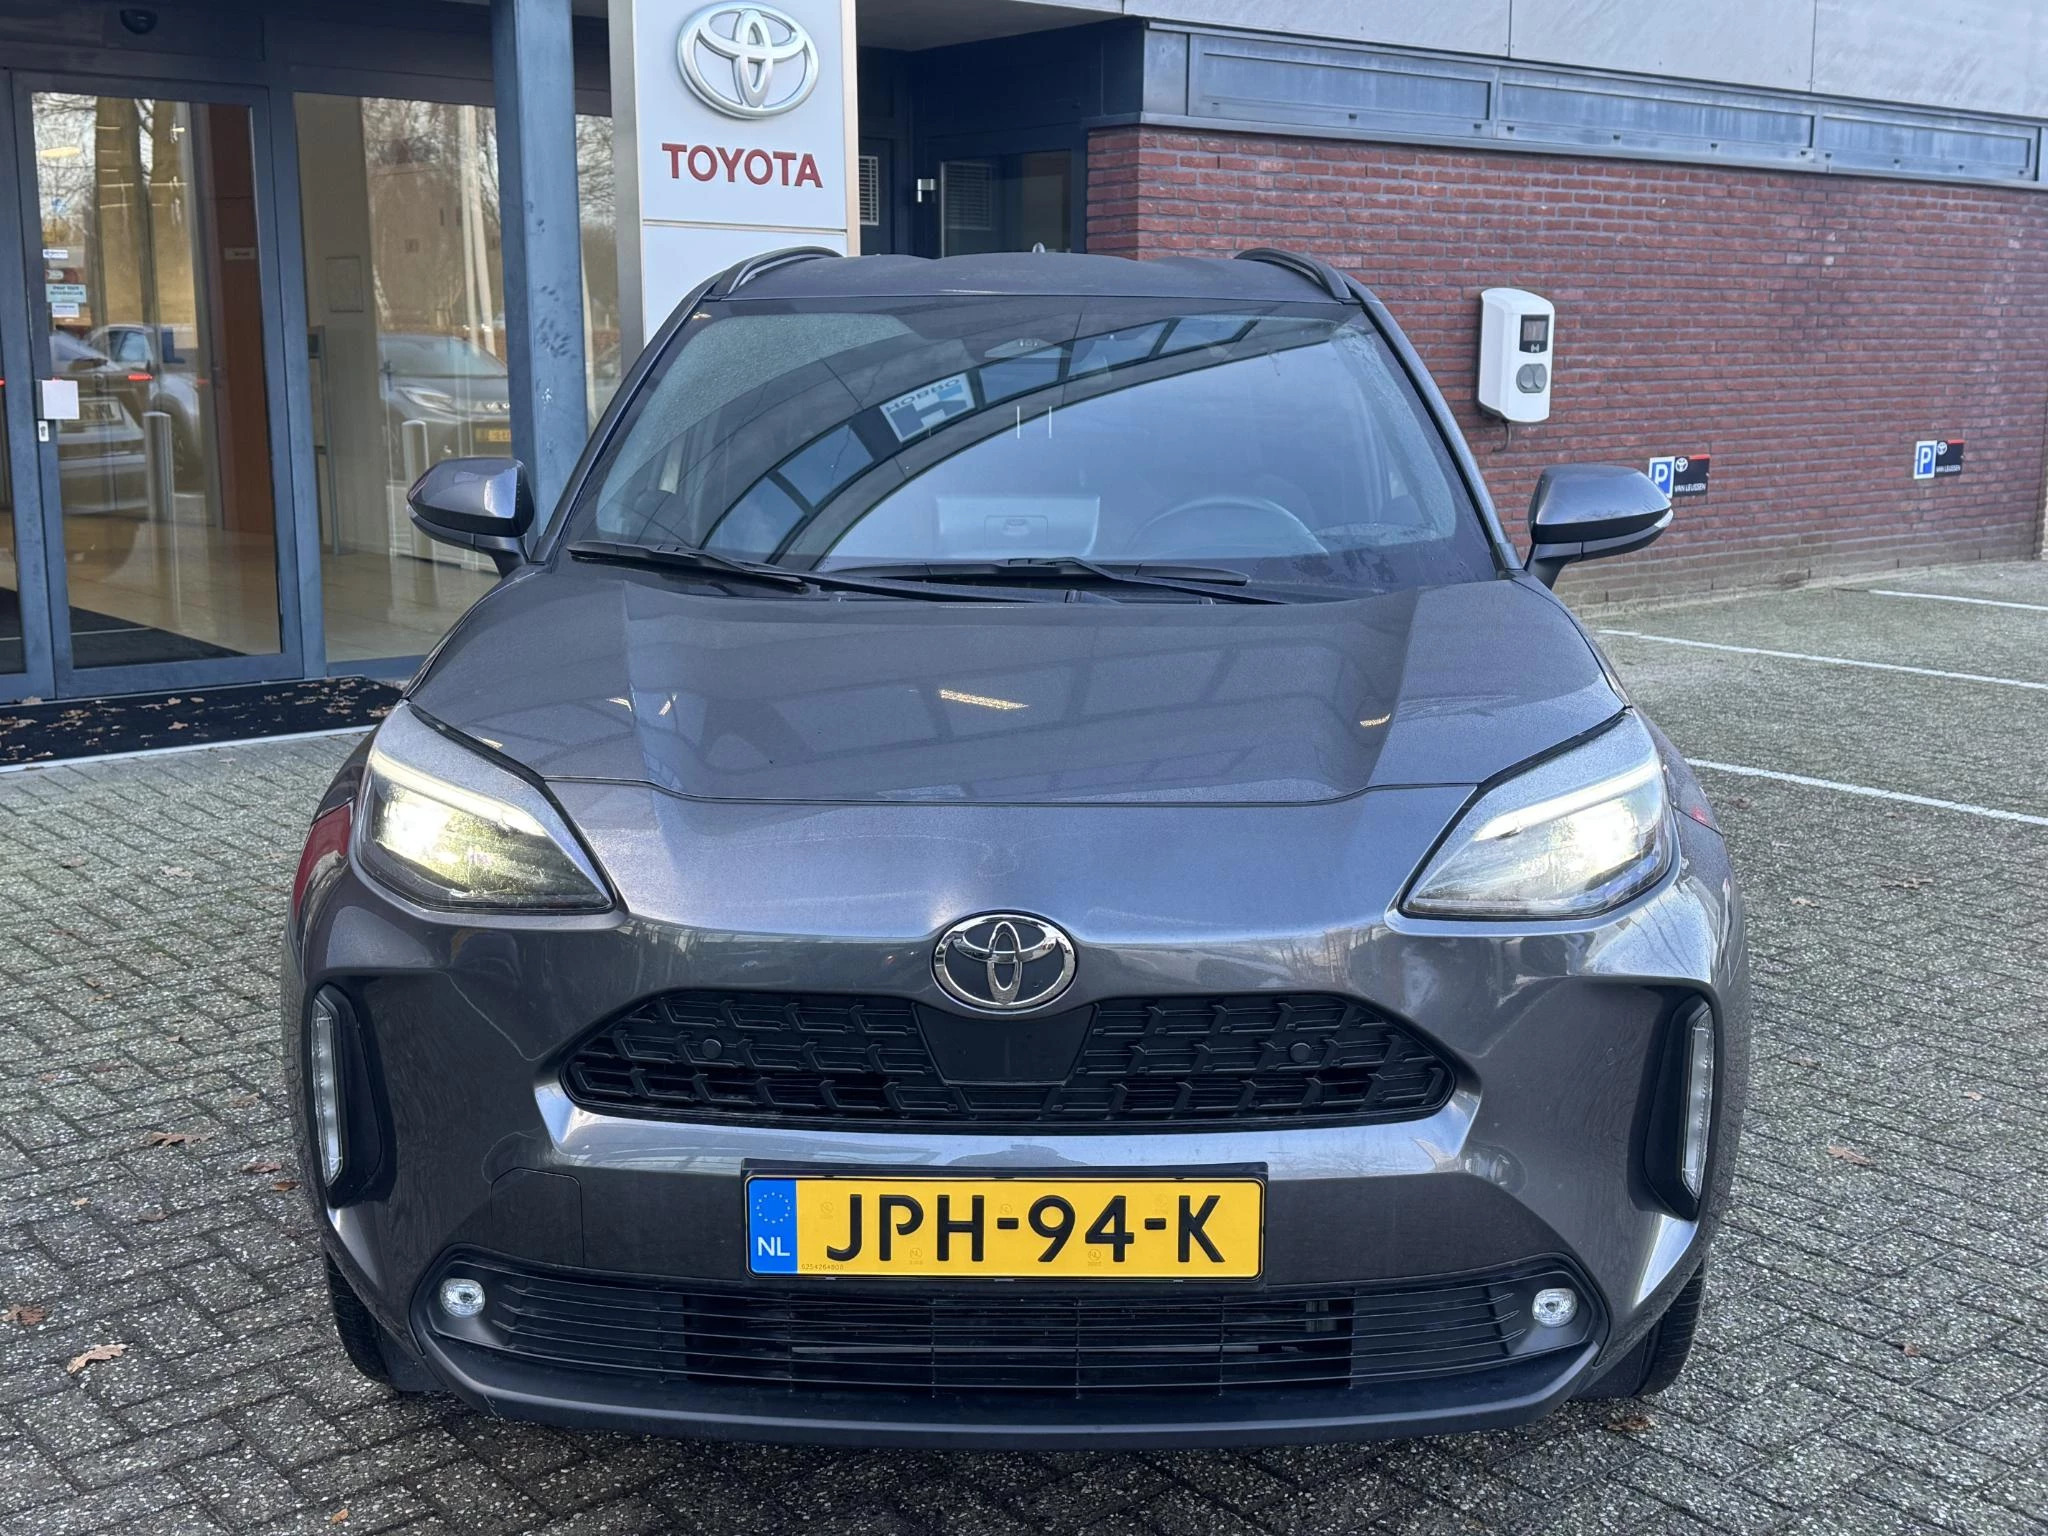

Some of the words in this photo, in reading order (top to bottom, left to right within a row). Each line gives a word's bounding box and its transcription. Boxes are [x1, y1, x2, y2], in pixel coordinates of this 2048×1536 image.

[662, 143, 823, 188] TOYOTA
[1919, 447, 1931, 473] P
[1654, 463, 1668, 486] P
[826, 1193, 1226, 1263] JPH-94-K
[757, 1236, 790, 1256] NL
